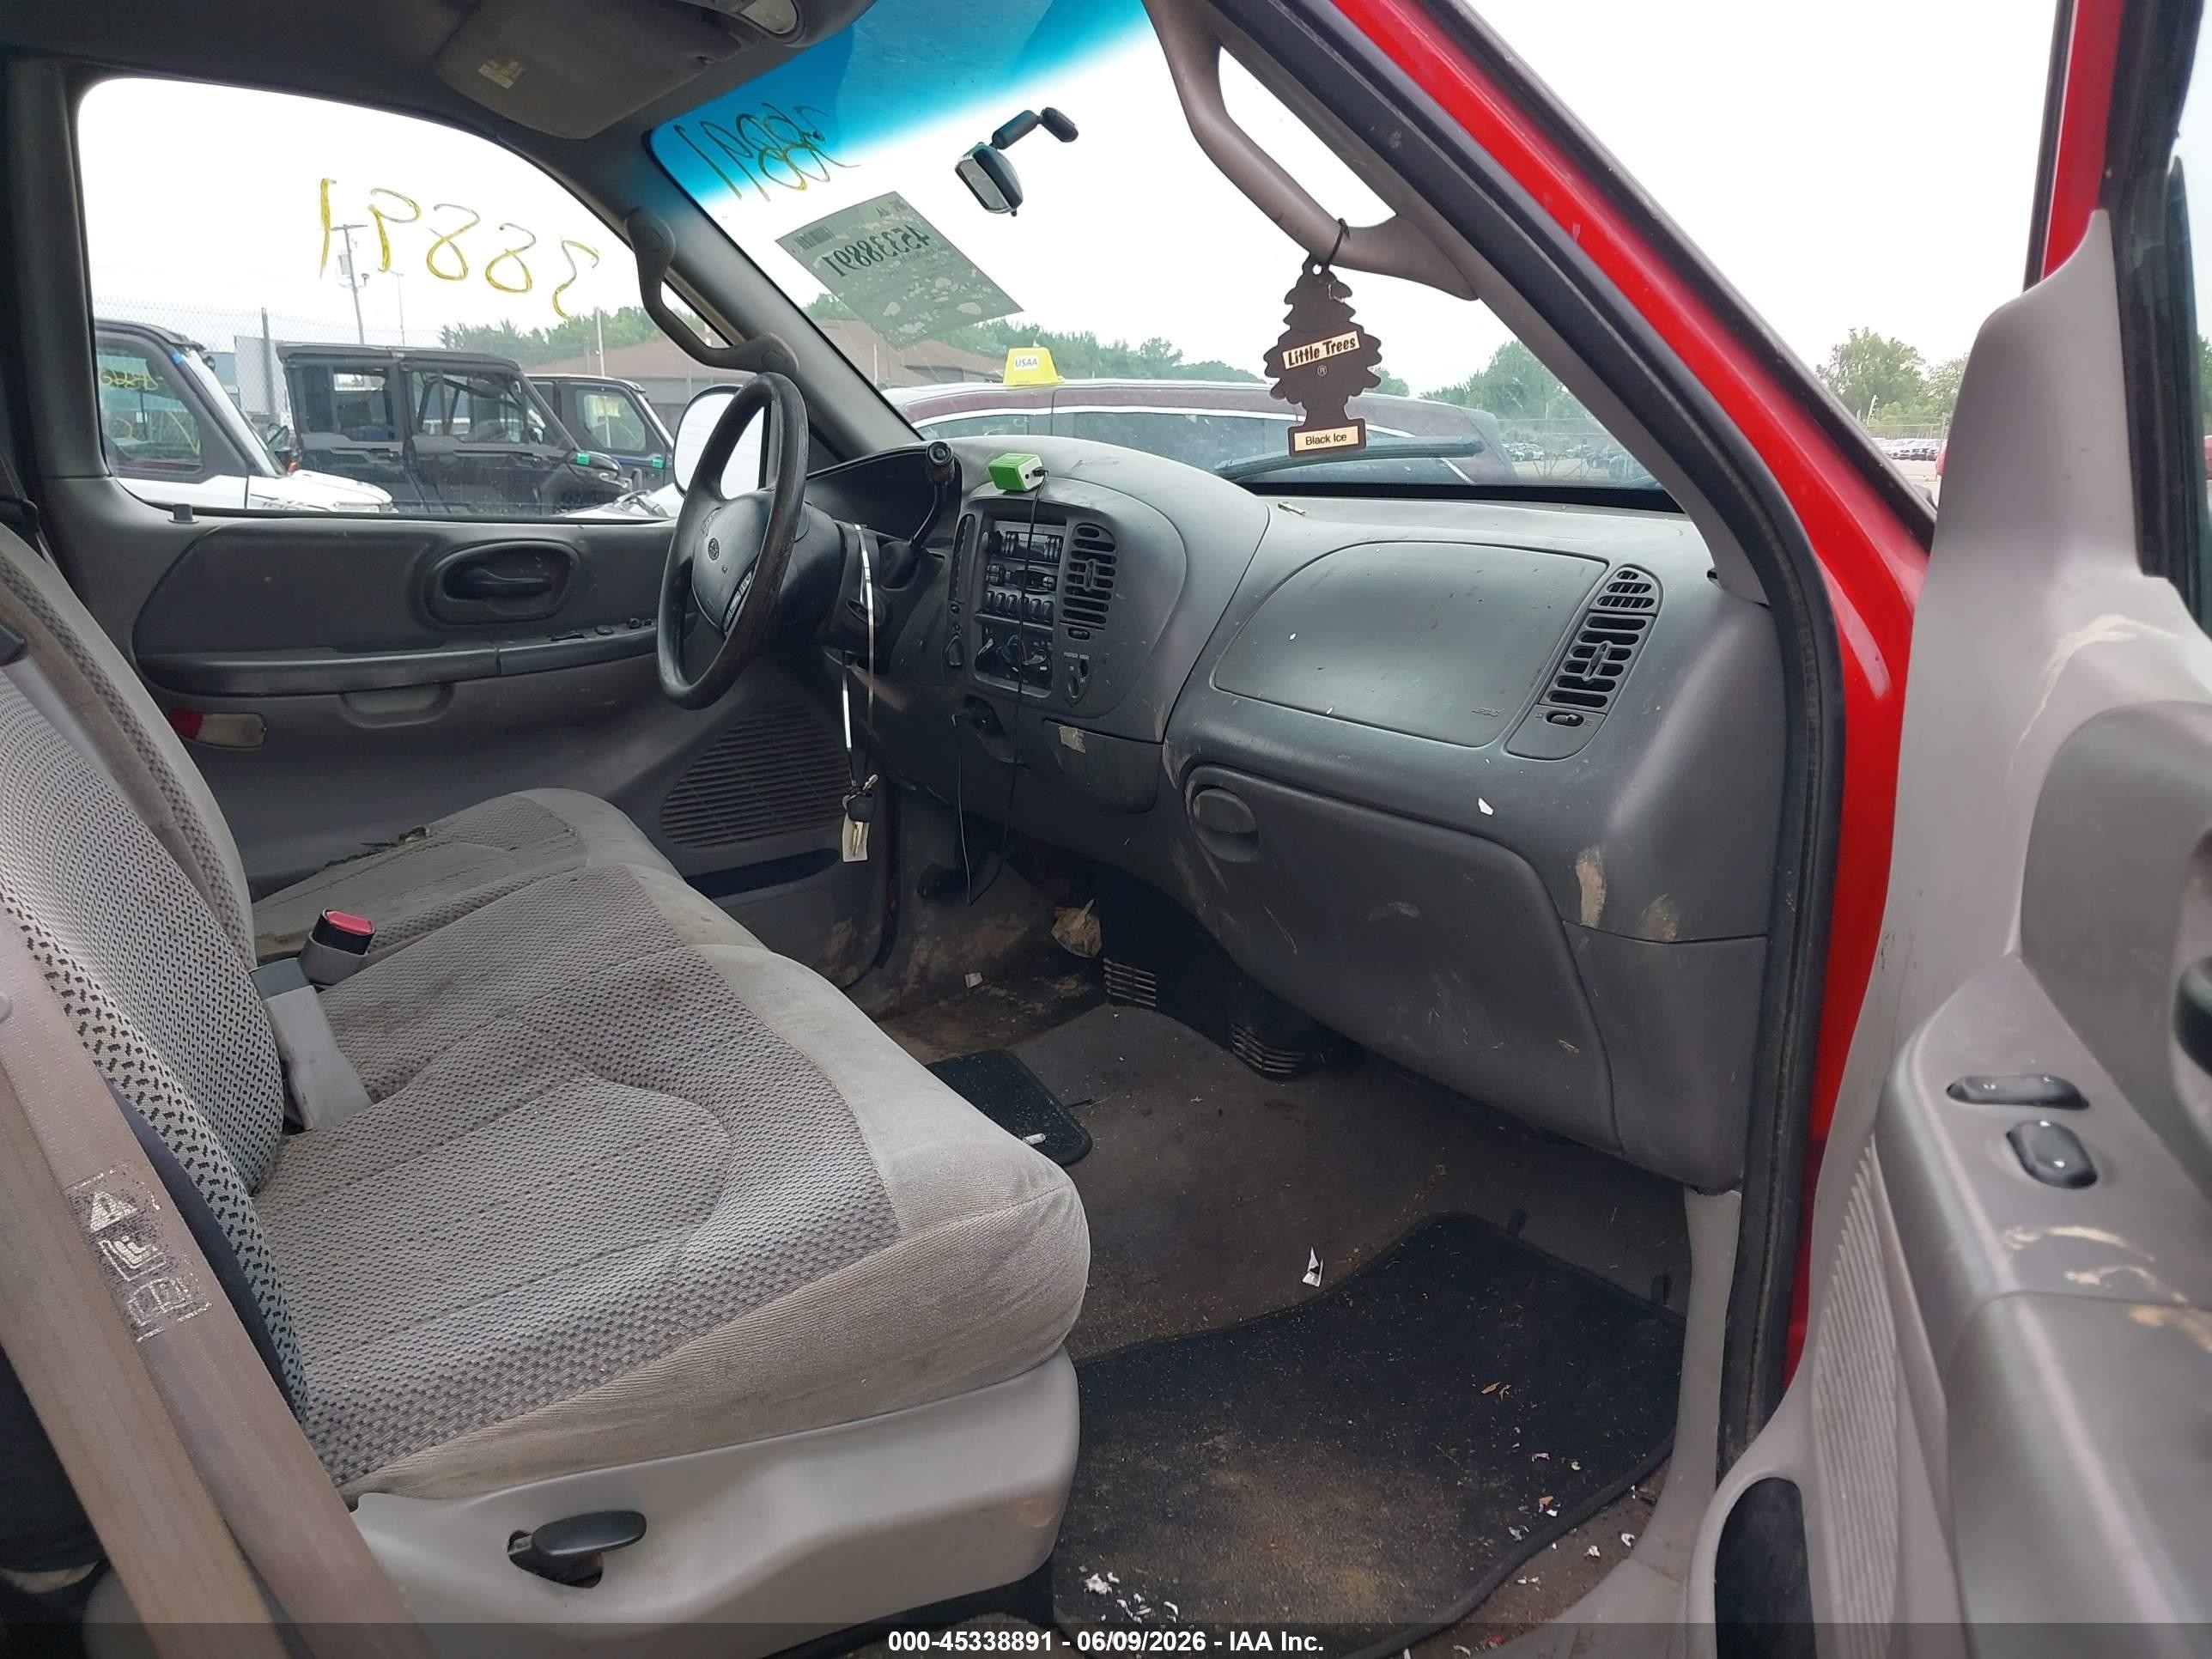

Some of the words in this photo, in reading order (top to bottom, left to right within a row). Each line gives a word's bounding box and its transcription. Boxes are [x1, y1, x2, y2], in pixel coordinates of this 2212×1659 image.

[1288, 345, 1320, 367] Little
[1322, 337, 1356, 356] Trees
[1015, 357, 1037, 368] USAA
[1305, 434, 1331, 446] Black
[1334, 433, 1347, 442] Ice
